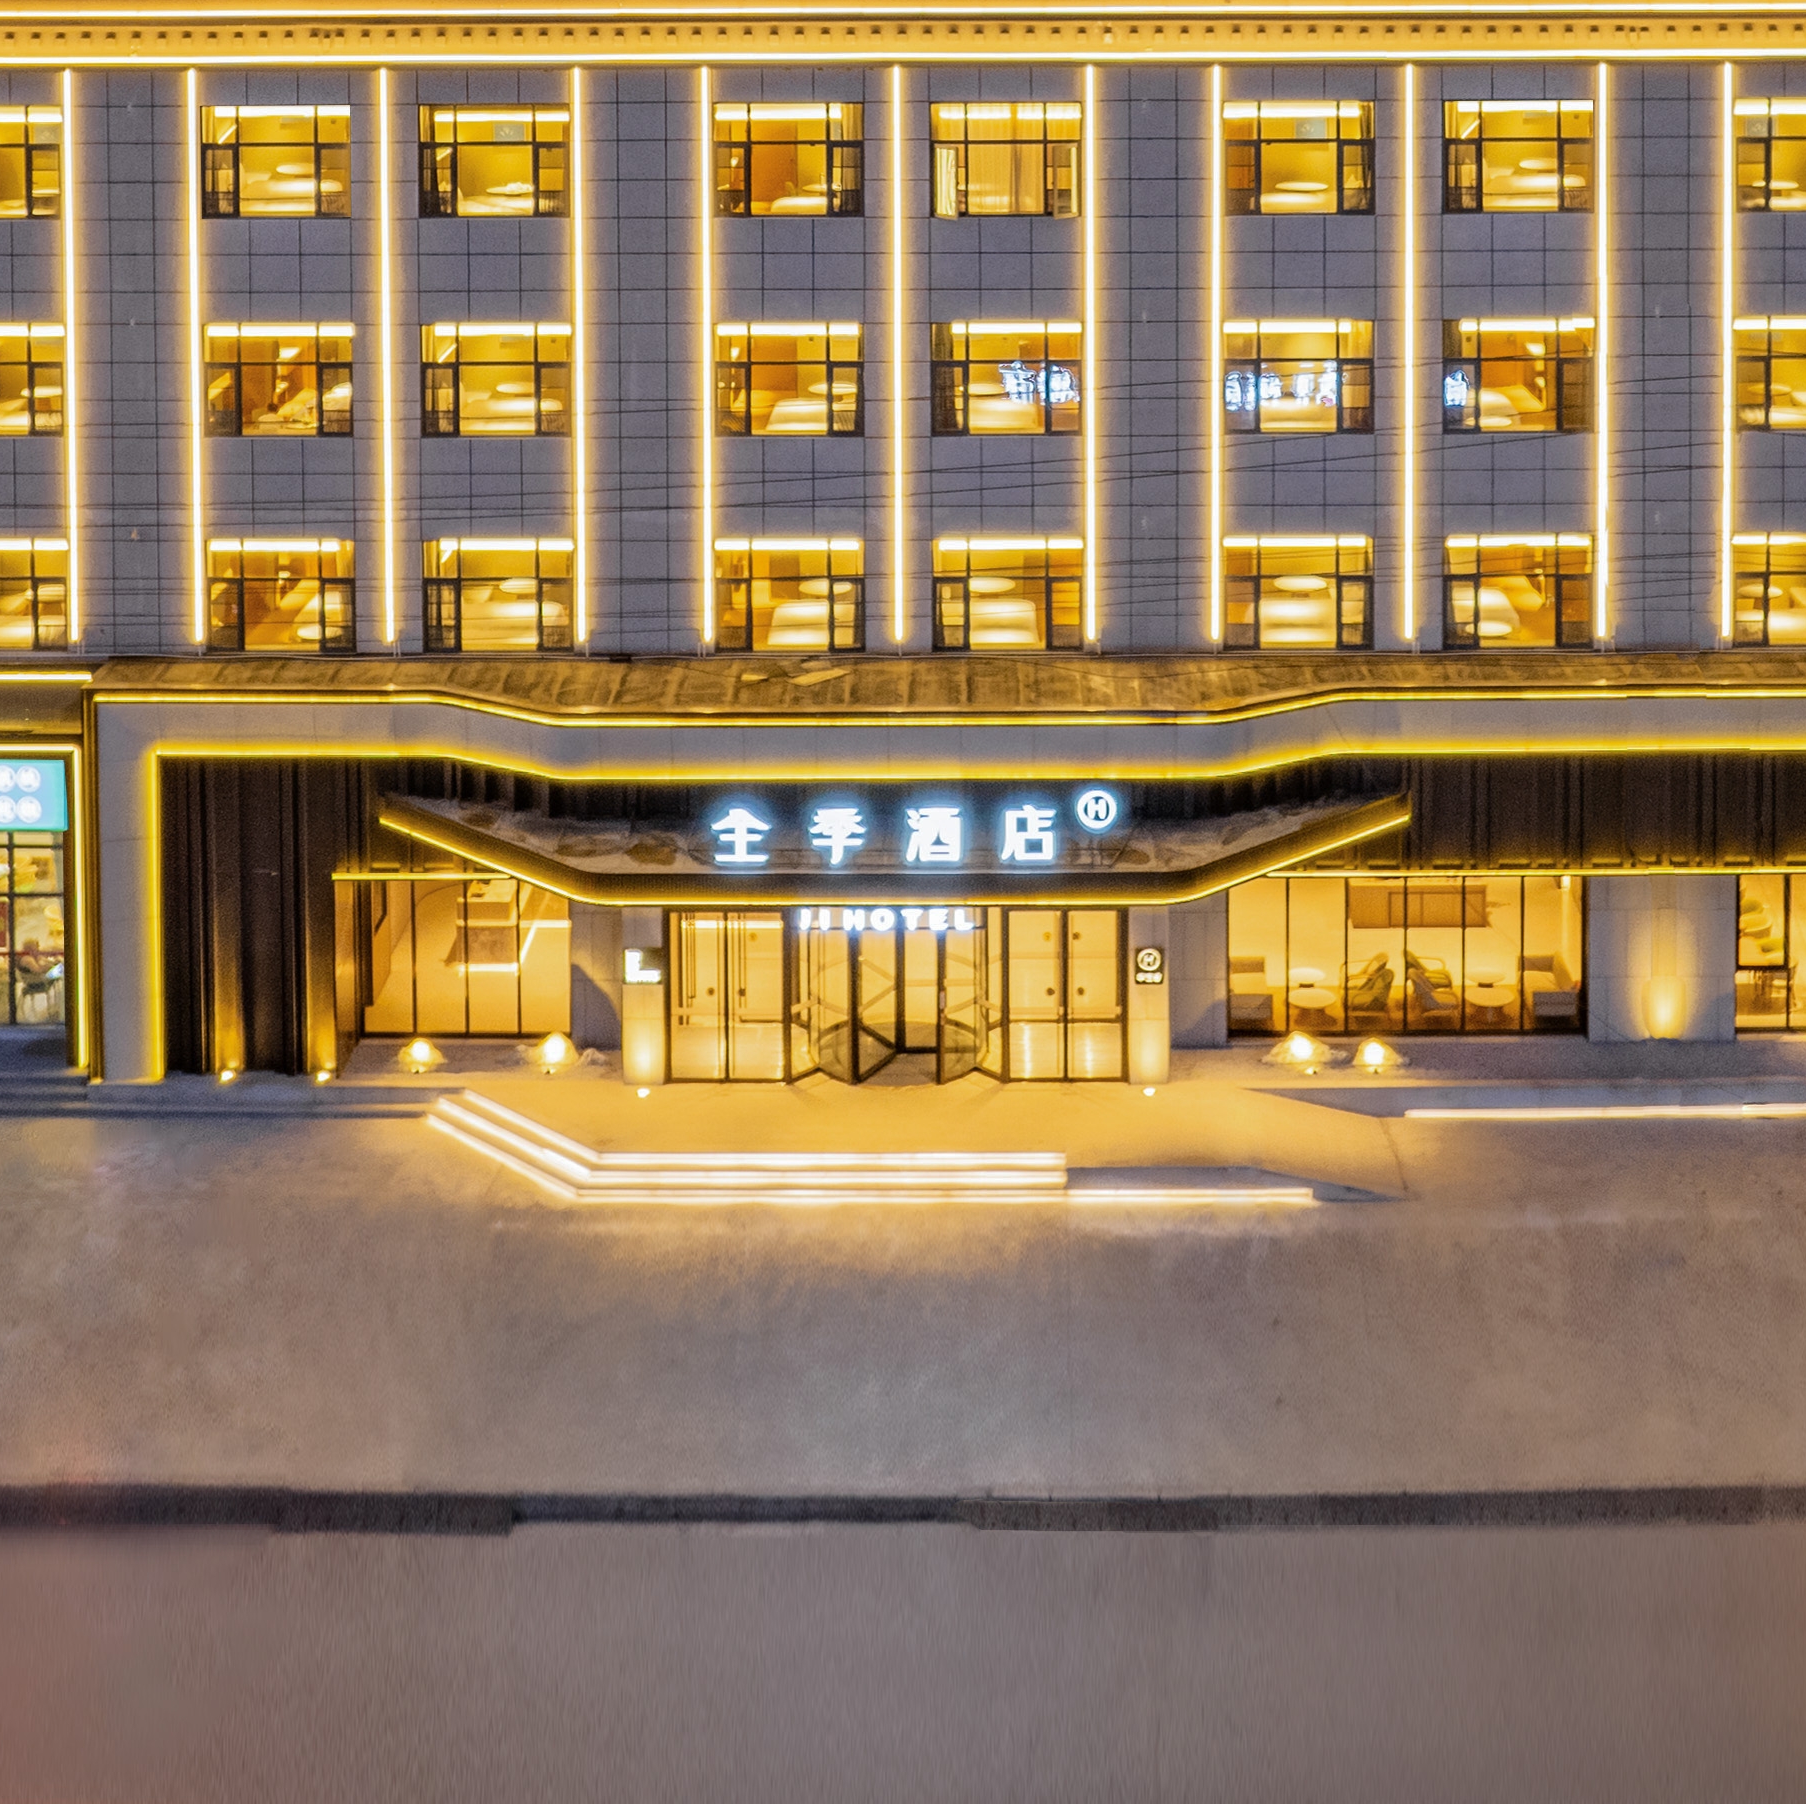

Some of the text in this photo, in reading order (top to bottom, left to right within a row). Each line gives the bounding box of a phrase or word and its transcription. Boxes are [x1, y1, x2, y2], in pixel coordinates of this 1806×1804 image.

[711, 805, 1057, 865] 全季酒店
[842, 902, 975, 931] HOTEL
